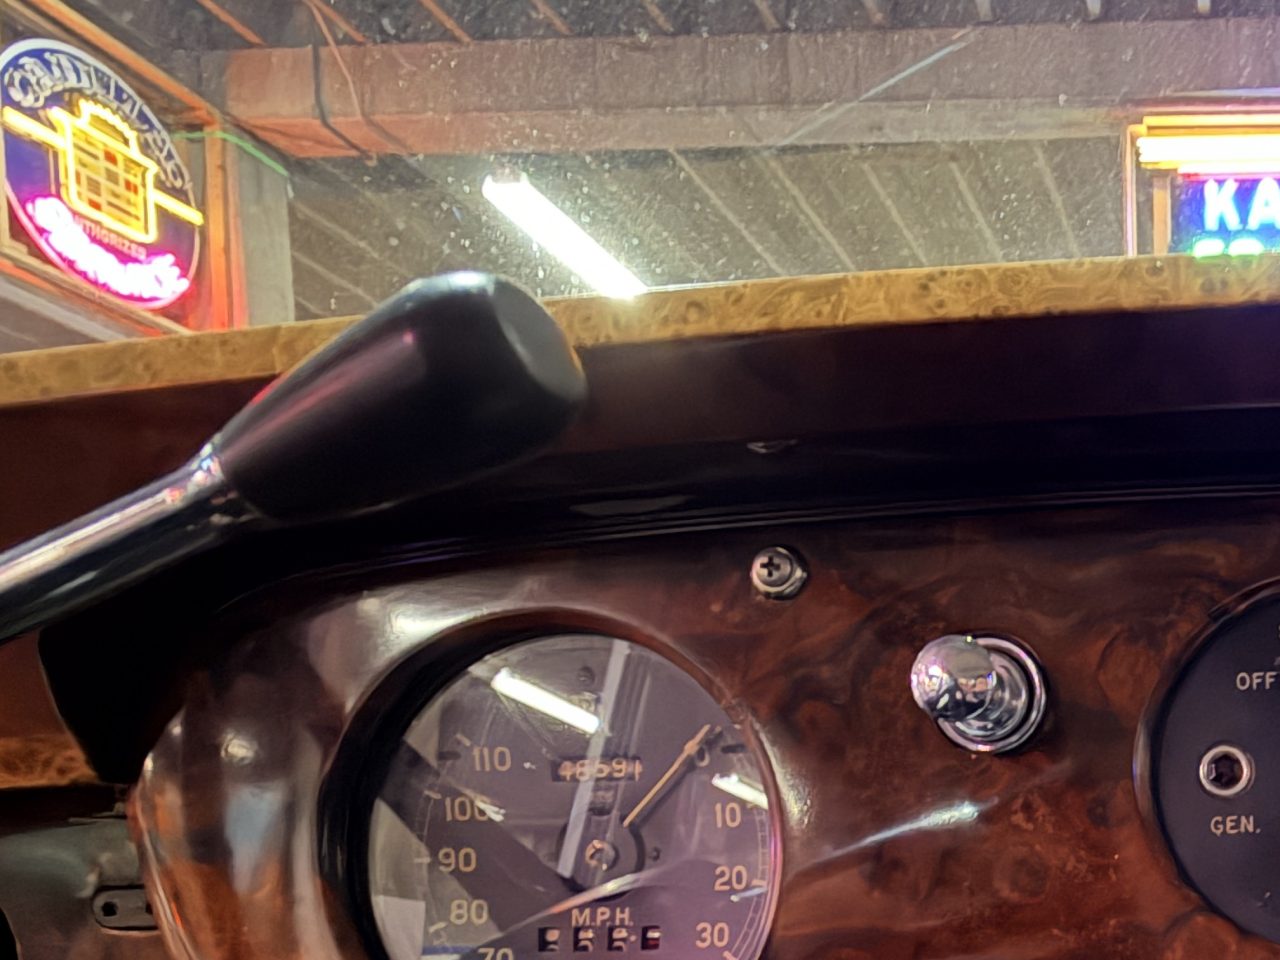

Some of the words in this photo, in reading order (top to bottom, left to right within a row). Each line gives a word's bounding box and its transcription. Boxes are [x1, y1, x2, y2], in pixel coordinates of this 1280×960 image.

[1236, 672, 1278, 691] OFF
[472, 746, 513, 772] 110
[445, 795, 493, 821] 100
[714, 803, 742, 828] 10
[1210, 815, 1262, 836] GEN.
[438, 847, 478, 873] 90
[714, 866, 748, 892] 20
[450, 900, 489, 926] 80
[571, 907, 635, 928] M.P.H.
[696, 922, 730, 948] 30
